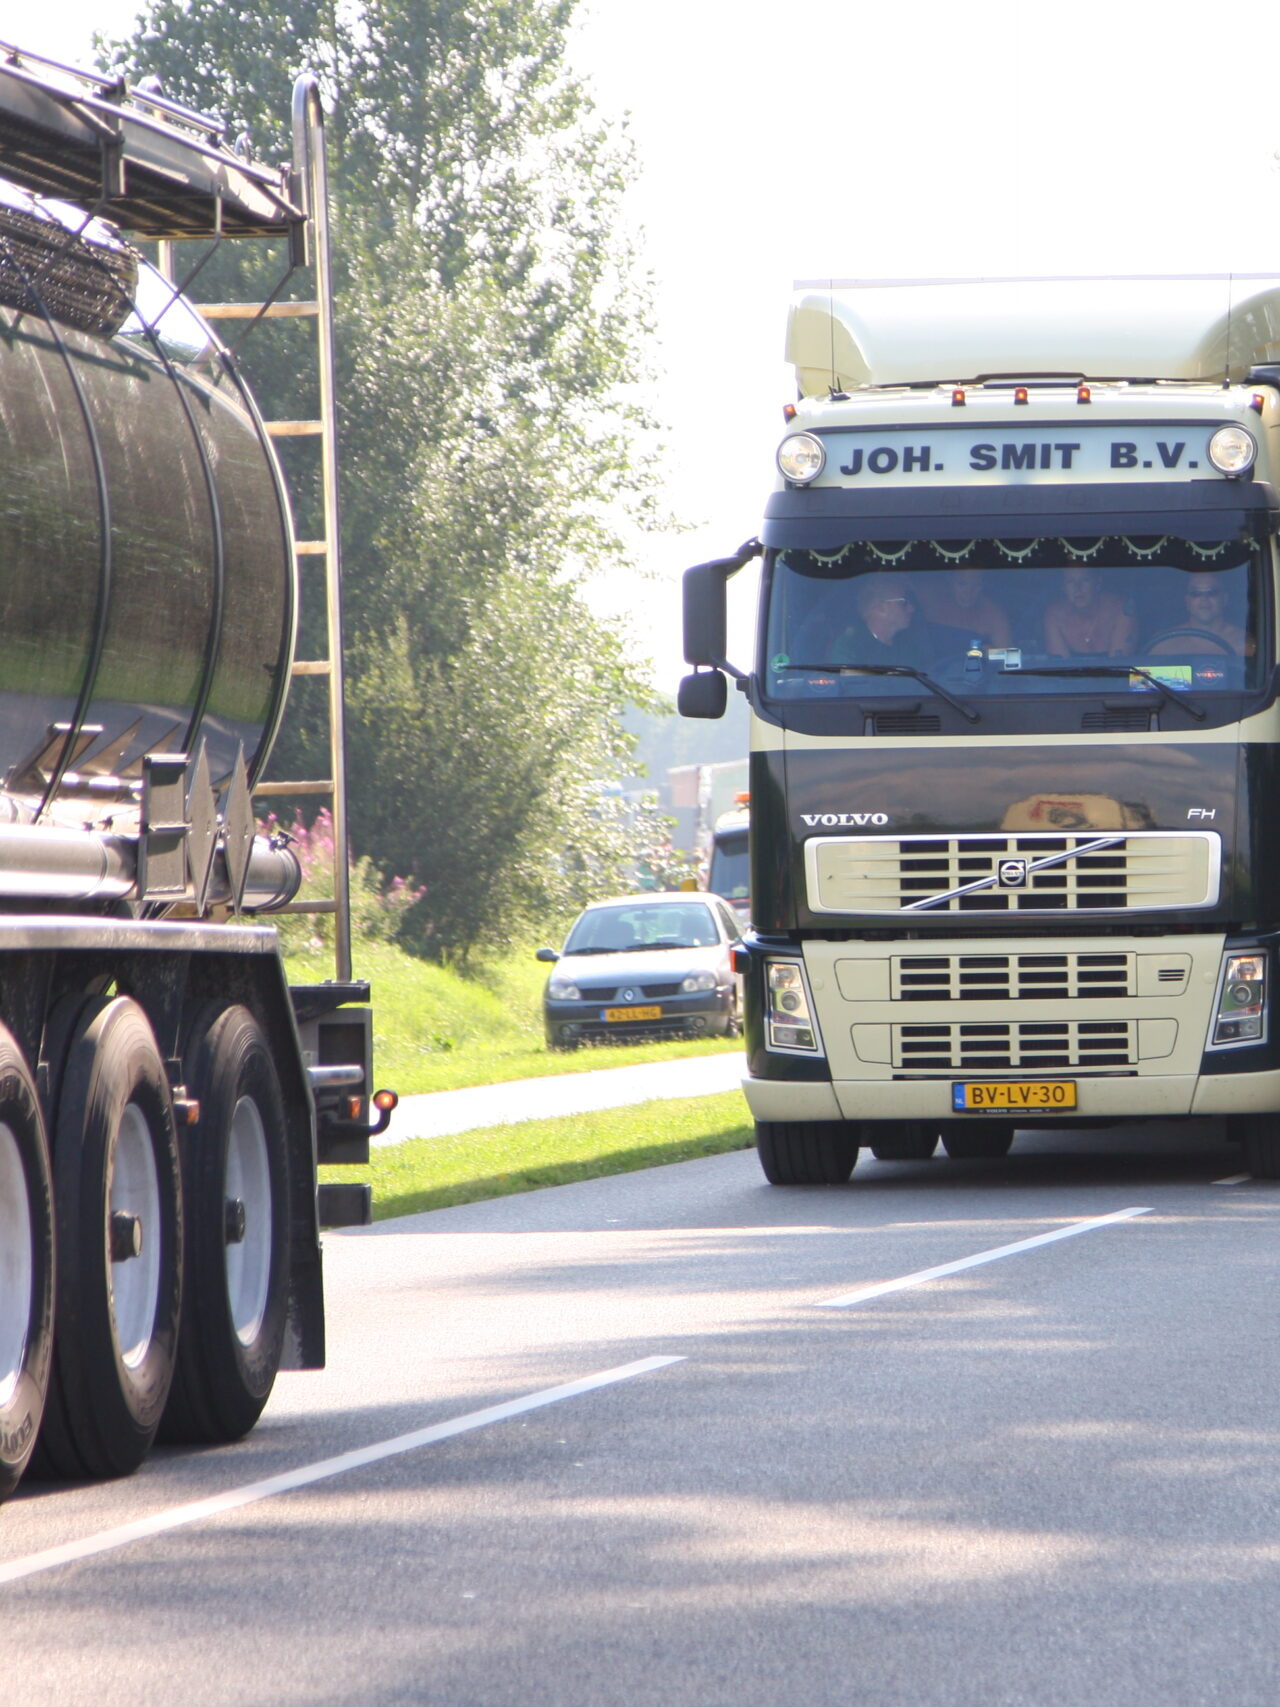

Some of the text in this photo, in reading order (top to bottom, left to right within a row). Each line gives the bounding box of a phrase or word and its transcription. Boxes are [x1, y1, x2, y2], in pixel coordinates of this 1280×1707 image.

[840, 441, 1200, 475] JOH. SMIT B.V.
[800, 813, 888, 827] VOLVO
[1187, 808, 1216, 821] FH
[972, 1085, 1066, 1104] BV-LV-30
